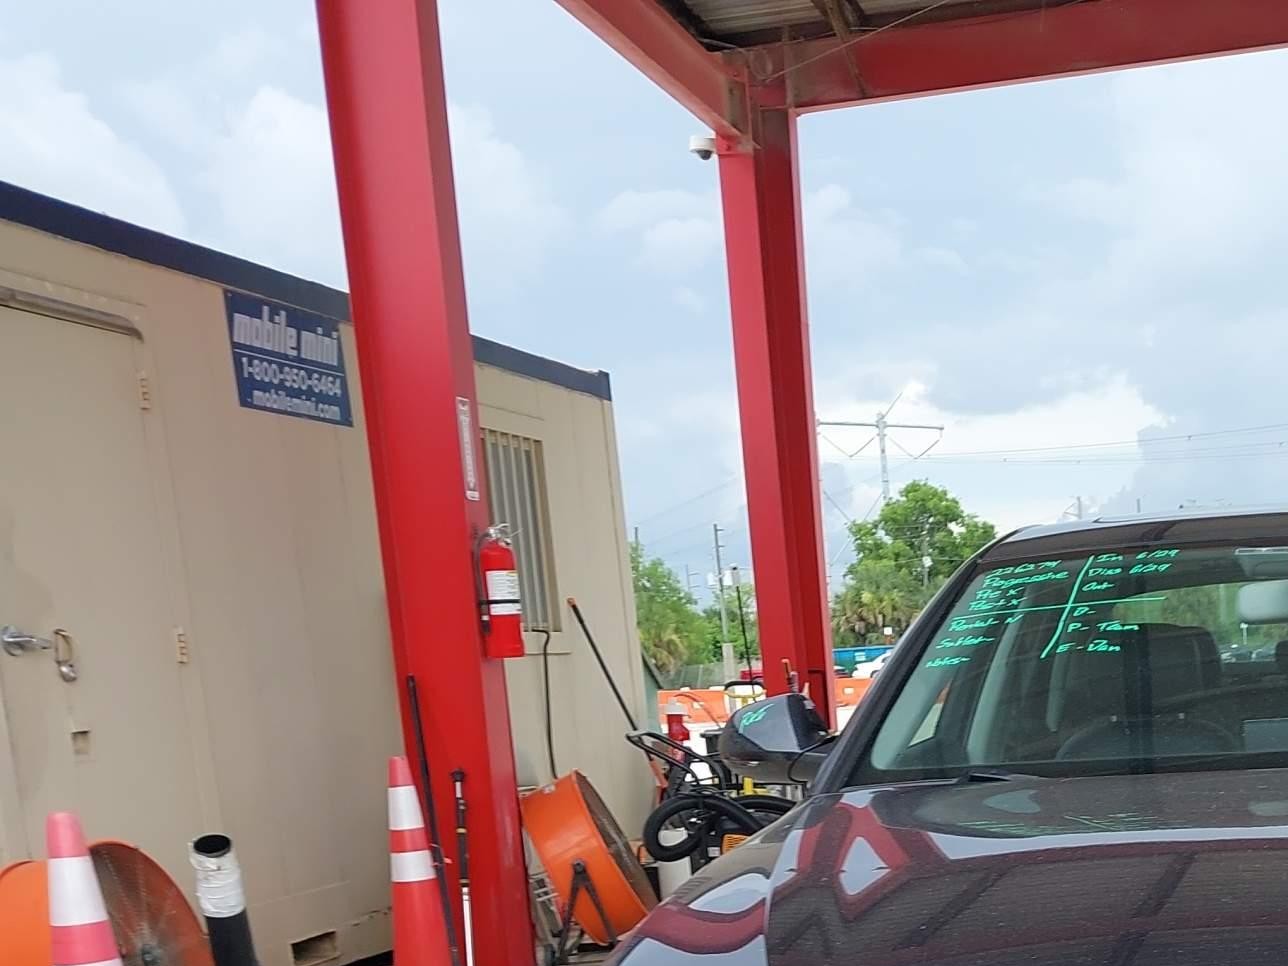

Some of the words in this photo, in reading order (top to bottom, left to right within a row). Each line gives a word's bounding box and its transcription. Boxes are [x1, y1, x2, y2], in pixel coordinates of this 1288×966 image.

[233, 305, 298, 357] mobile
[301, 327, 338, 366] mini
[252, 389, 342, 421] mobilemini.com
